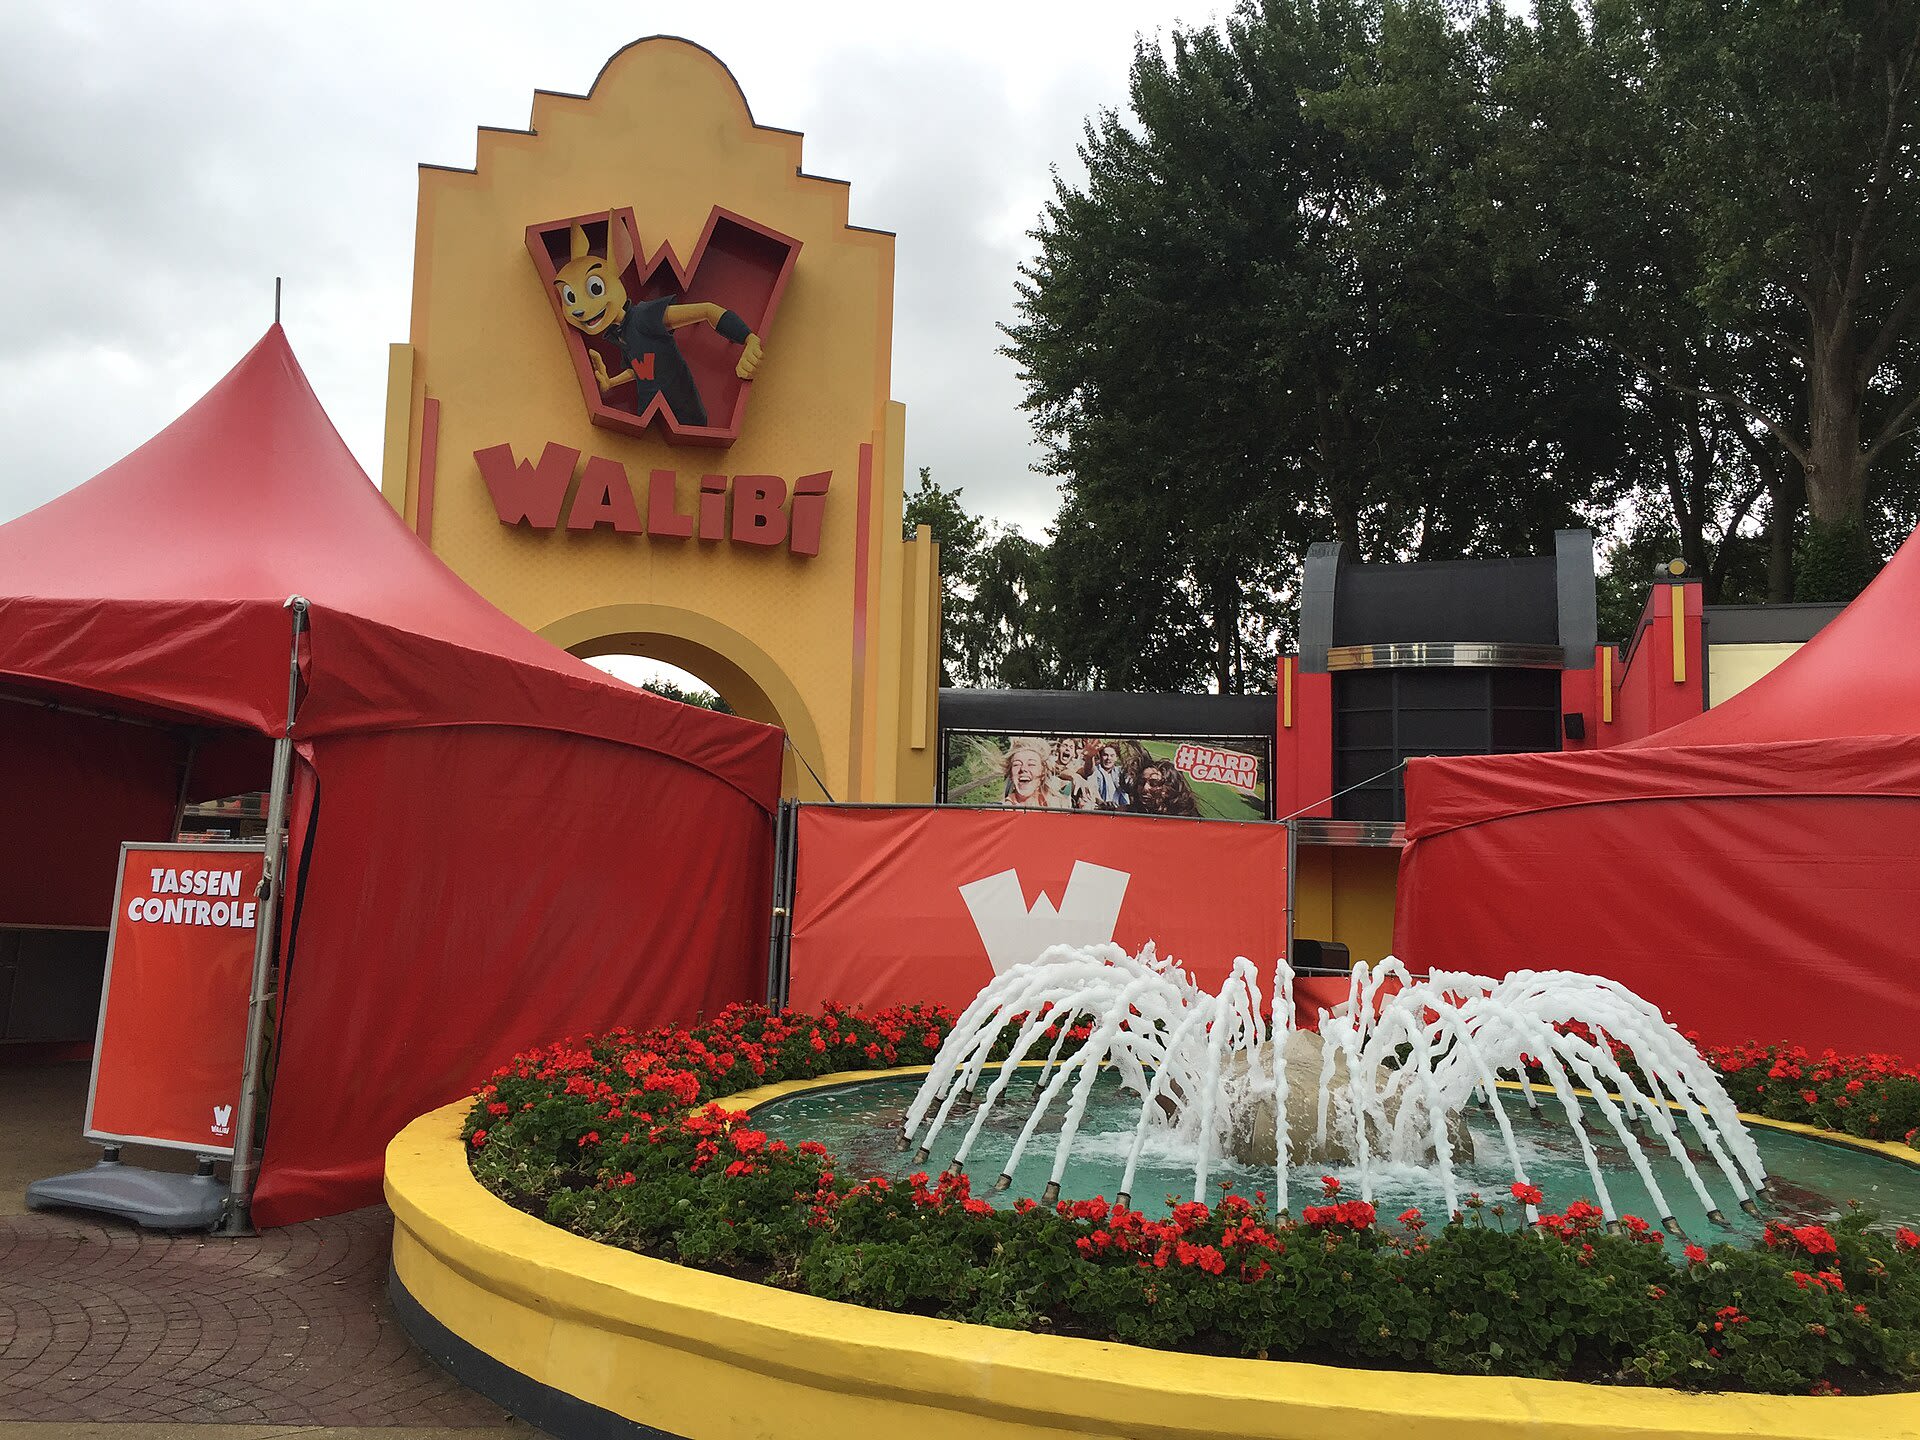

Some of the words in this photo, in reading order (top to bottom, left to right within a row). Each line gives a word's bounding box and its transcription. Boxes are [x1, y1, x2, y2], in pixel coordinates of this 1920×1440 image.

[525, 204, 804, 448] W
[631, 352, 655, 380] W
[1177, 747, 1255, 772] #HARD
[1191, 764, 1254, 788] GAAN
[150, 868, 242, 897] TASSEN
[127, 897, 256, 928] CONTROLE
[958, 860, 1131, 978] W
[213, 1104, 233, 1127] W
